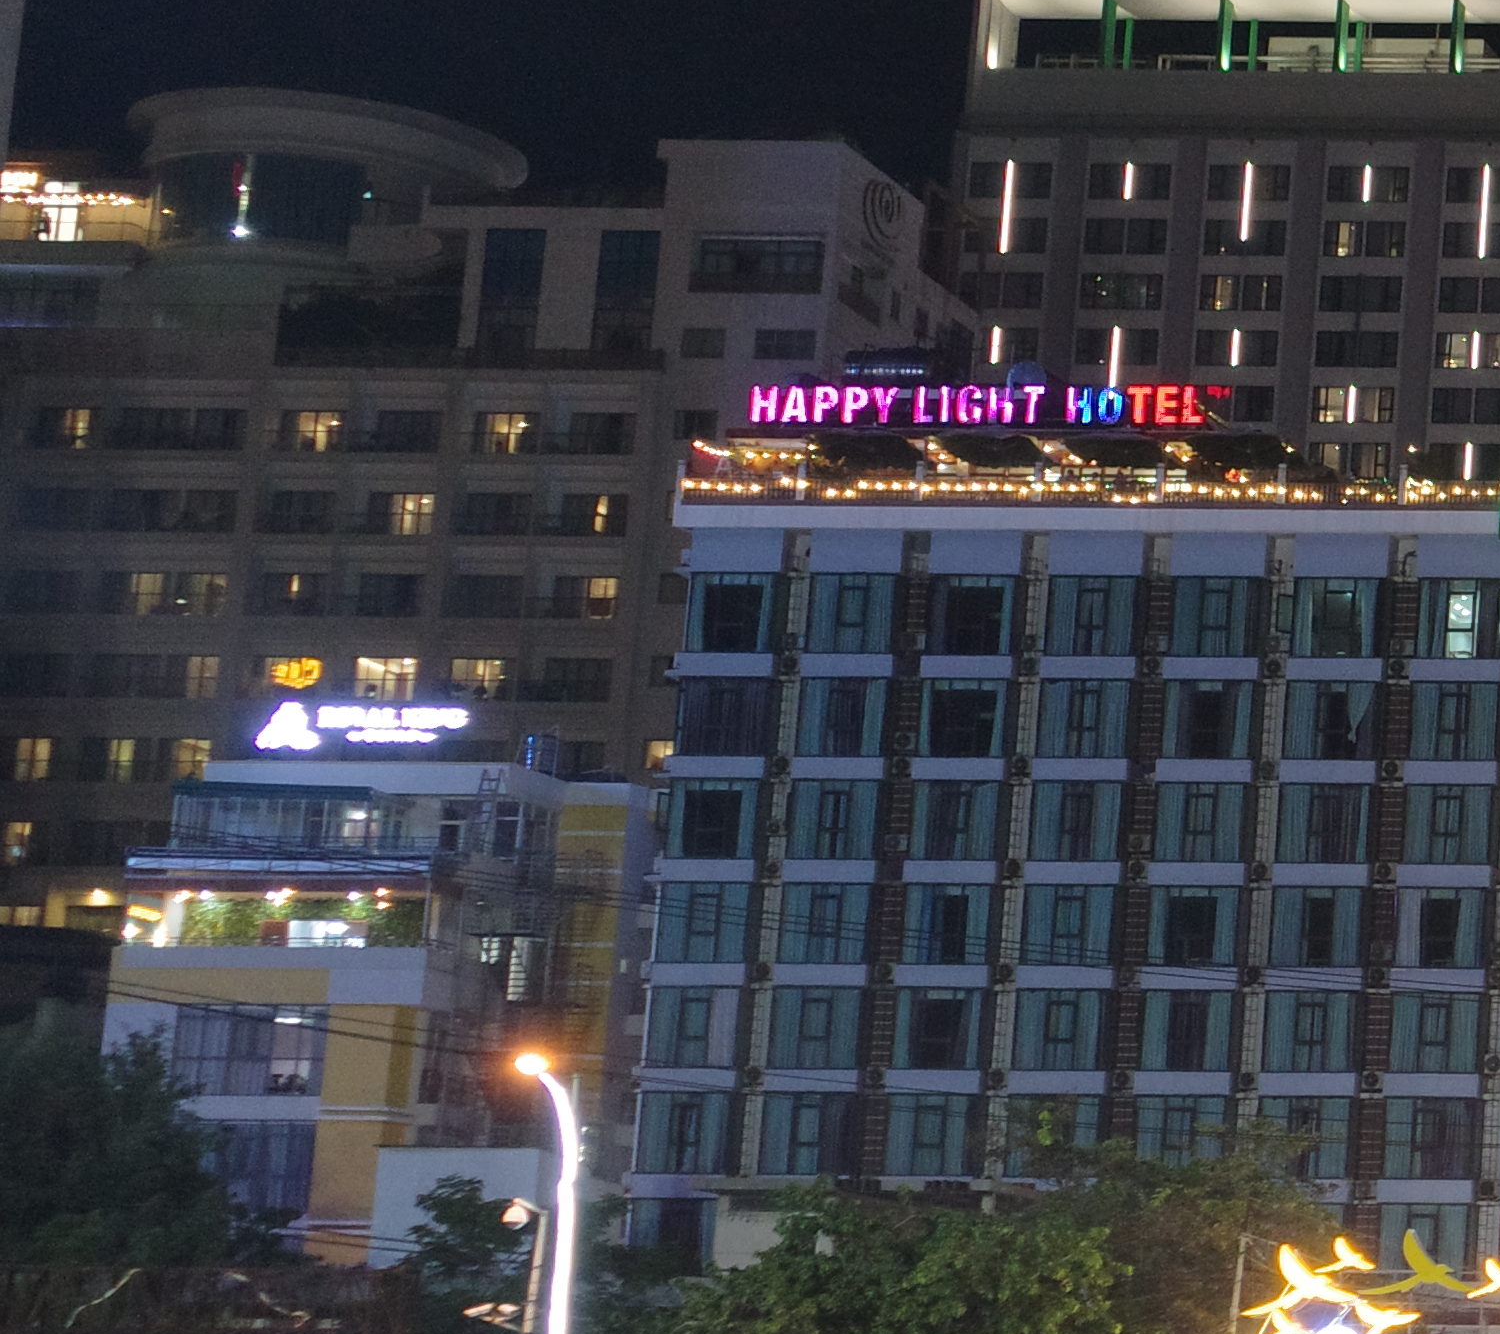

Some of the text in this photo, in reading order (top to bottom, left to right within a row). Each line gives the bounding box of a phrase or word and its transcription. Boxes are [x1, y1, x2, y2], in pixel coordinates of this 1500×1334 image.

[751, 384, 1206, 425] HAPPY LIGHT HOTEL
